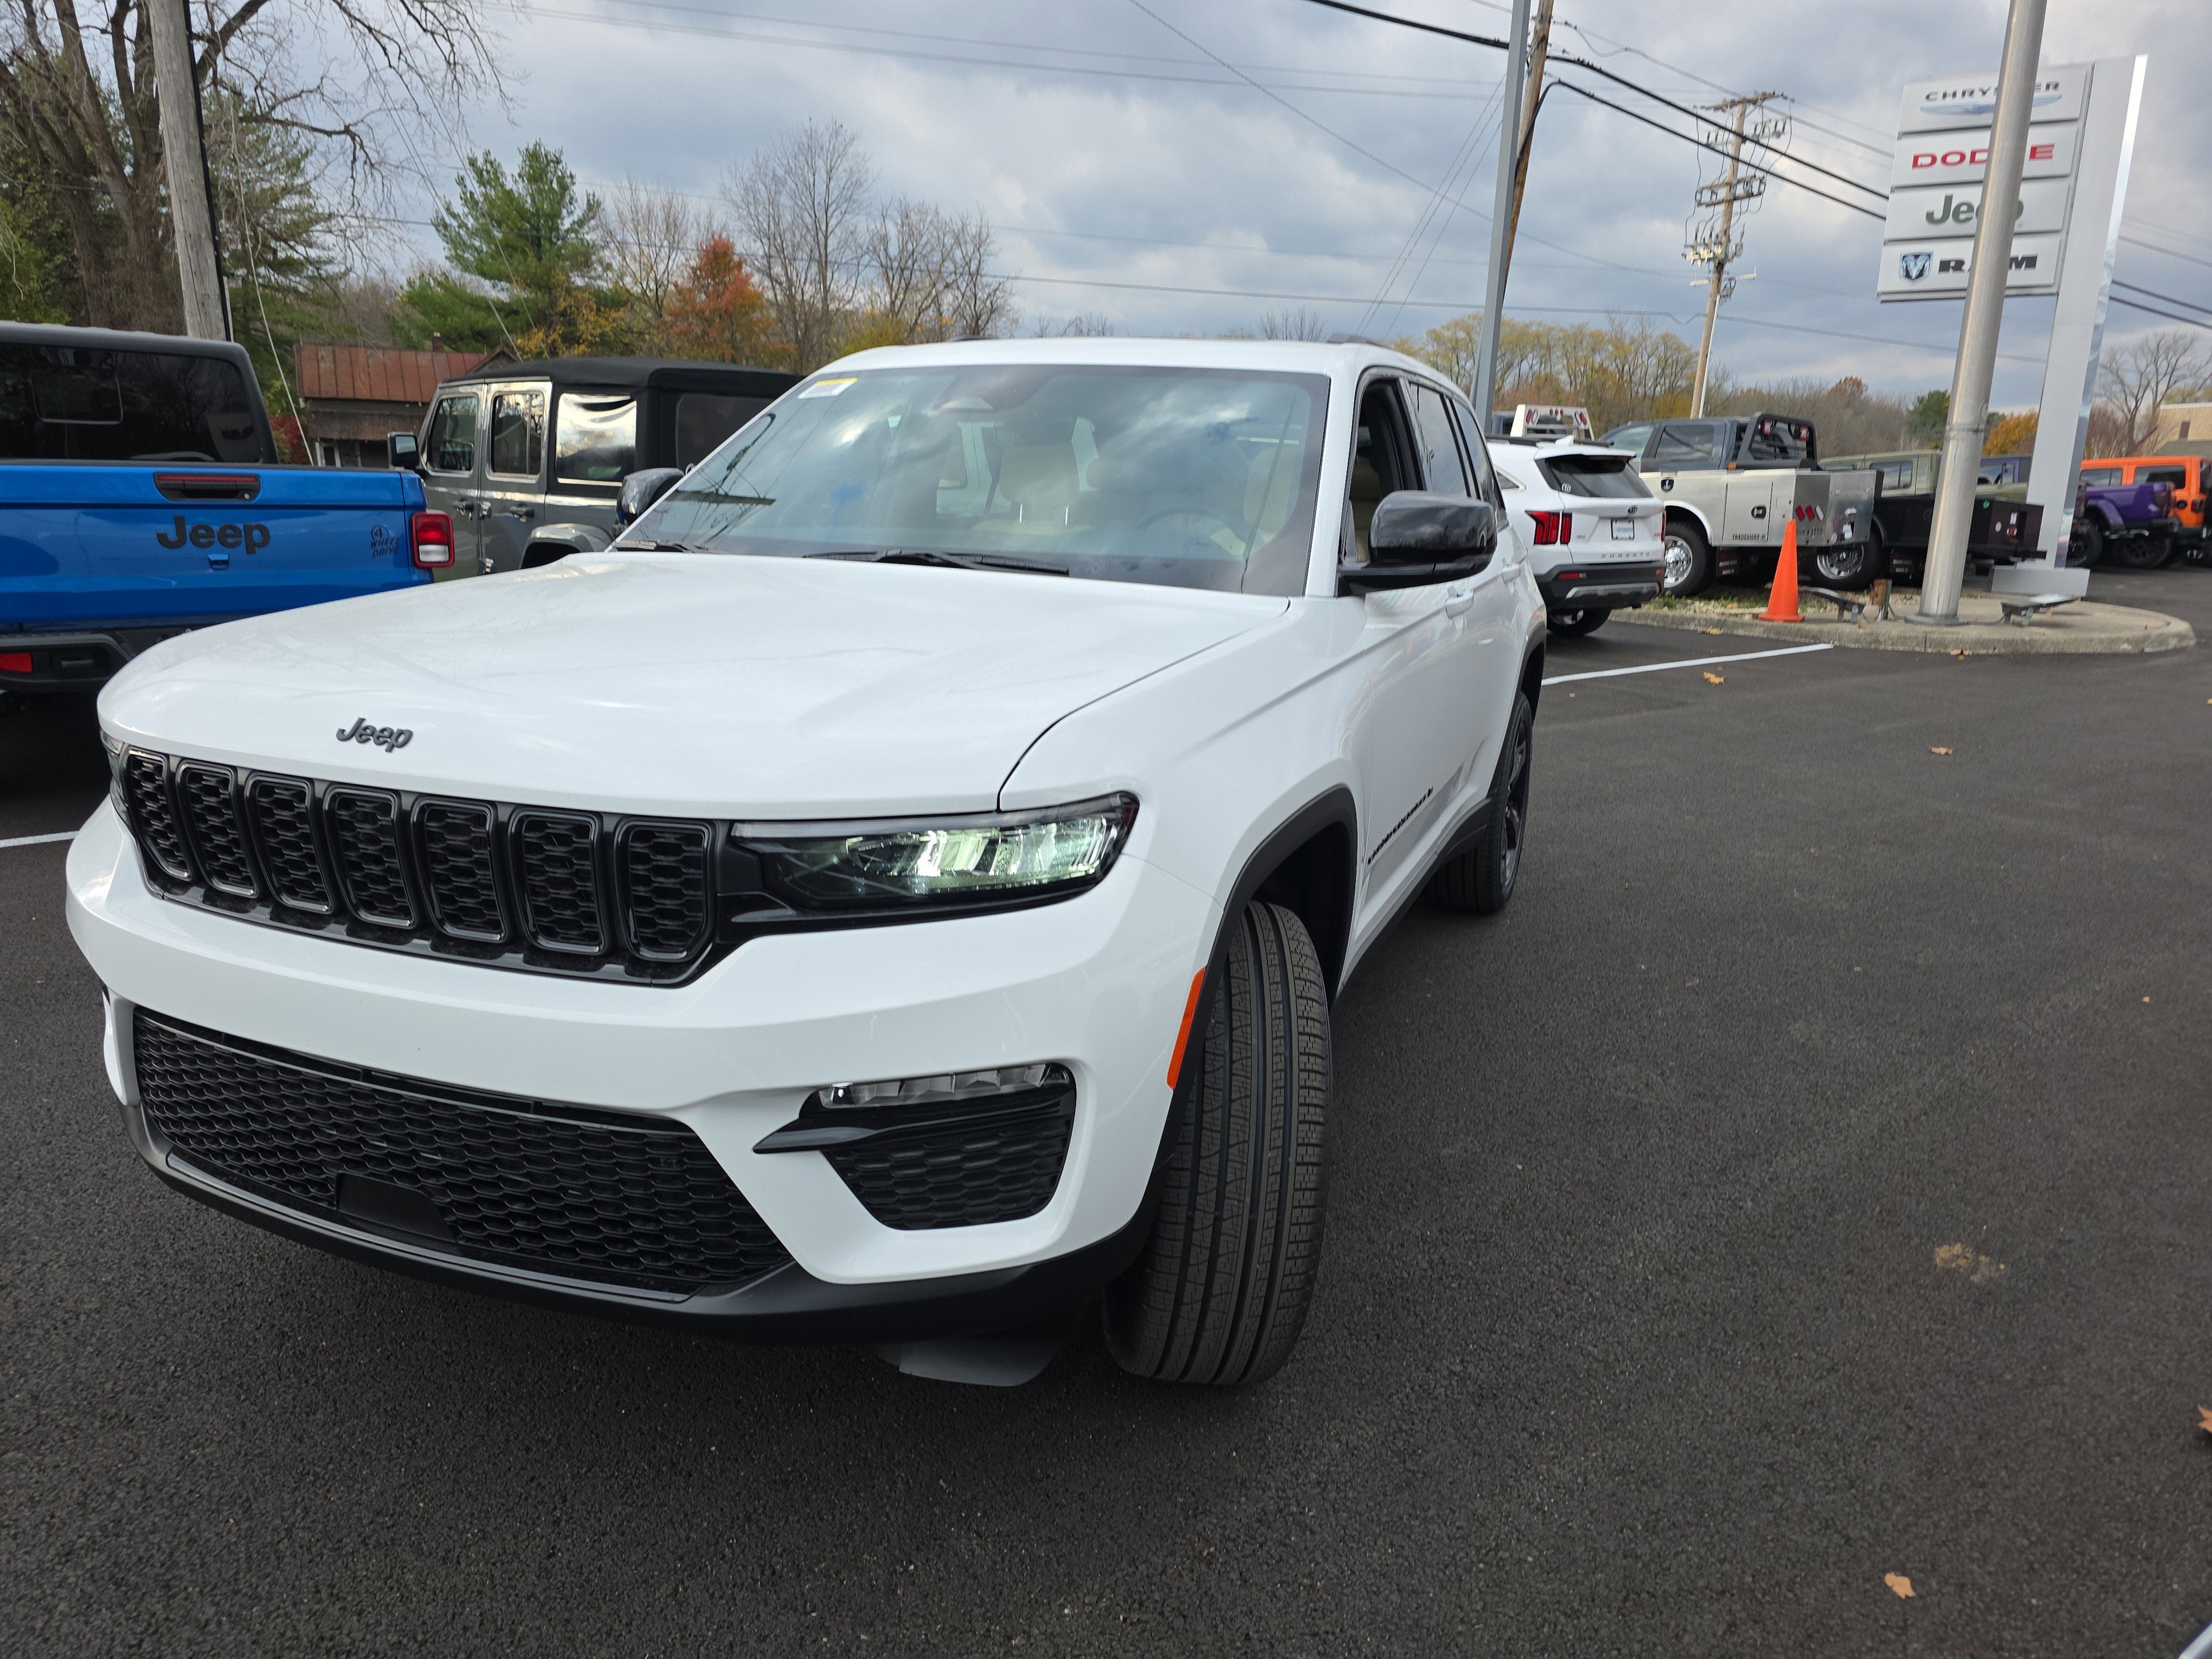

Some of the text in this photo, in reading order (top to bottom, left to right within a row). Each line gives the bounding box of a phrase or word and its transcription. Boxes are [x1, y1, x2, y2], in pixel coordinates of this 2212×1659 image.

[1912, 143, 2055, 170] DODE
[1938, 253, 2038, 274] RM
[156, 515, 271, 554] Jeep
[336, 717, 413, 753] Jeep
